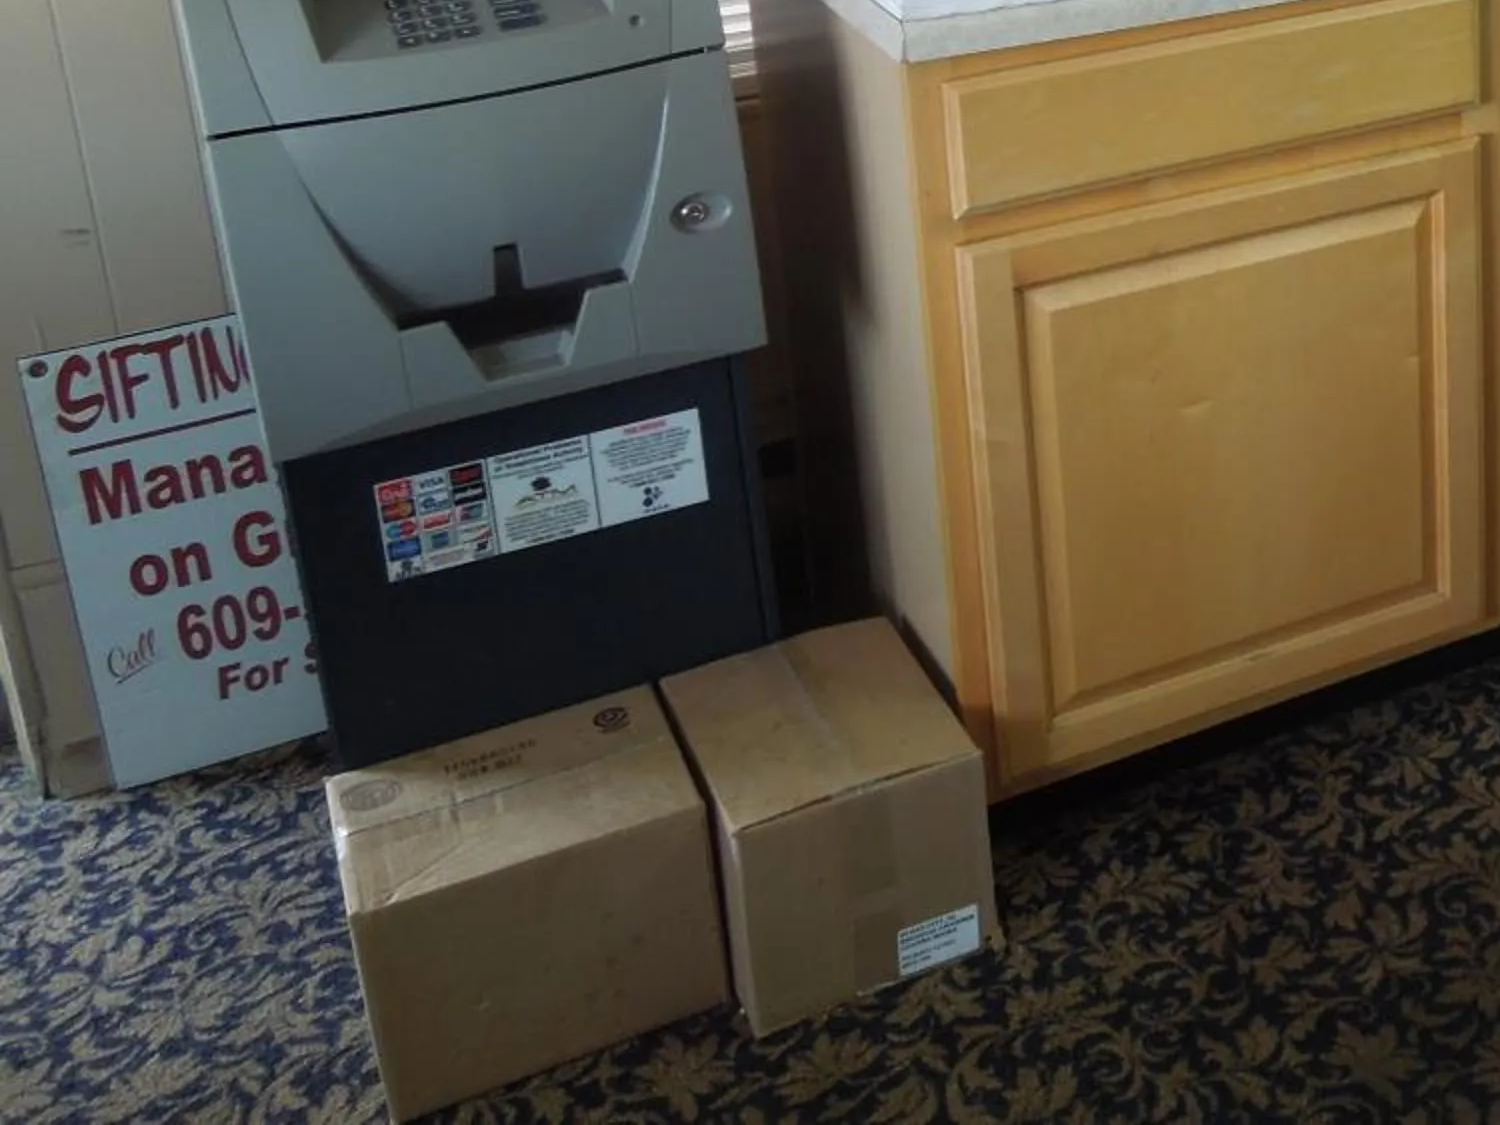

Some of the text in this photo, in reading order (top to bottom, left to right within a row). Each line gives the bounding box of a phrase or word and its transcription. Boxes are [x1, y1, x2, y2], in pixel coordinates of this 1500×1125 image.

[56, 327, 250, 433] SIFTIN
[80, 445, 267, 525] Mana
[130, 511, 282, 596] on G
[107, 628, 156, 680] Call
[218, 657, 289, 699] For
